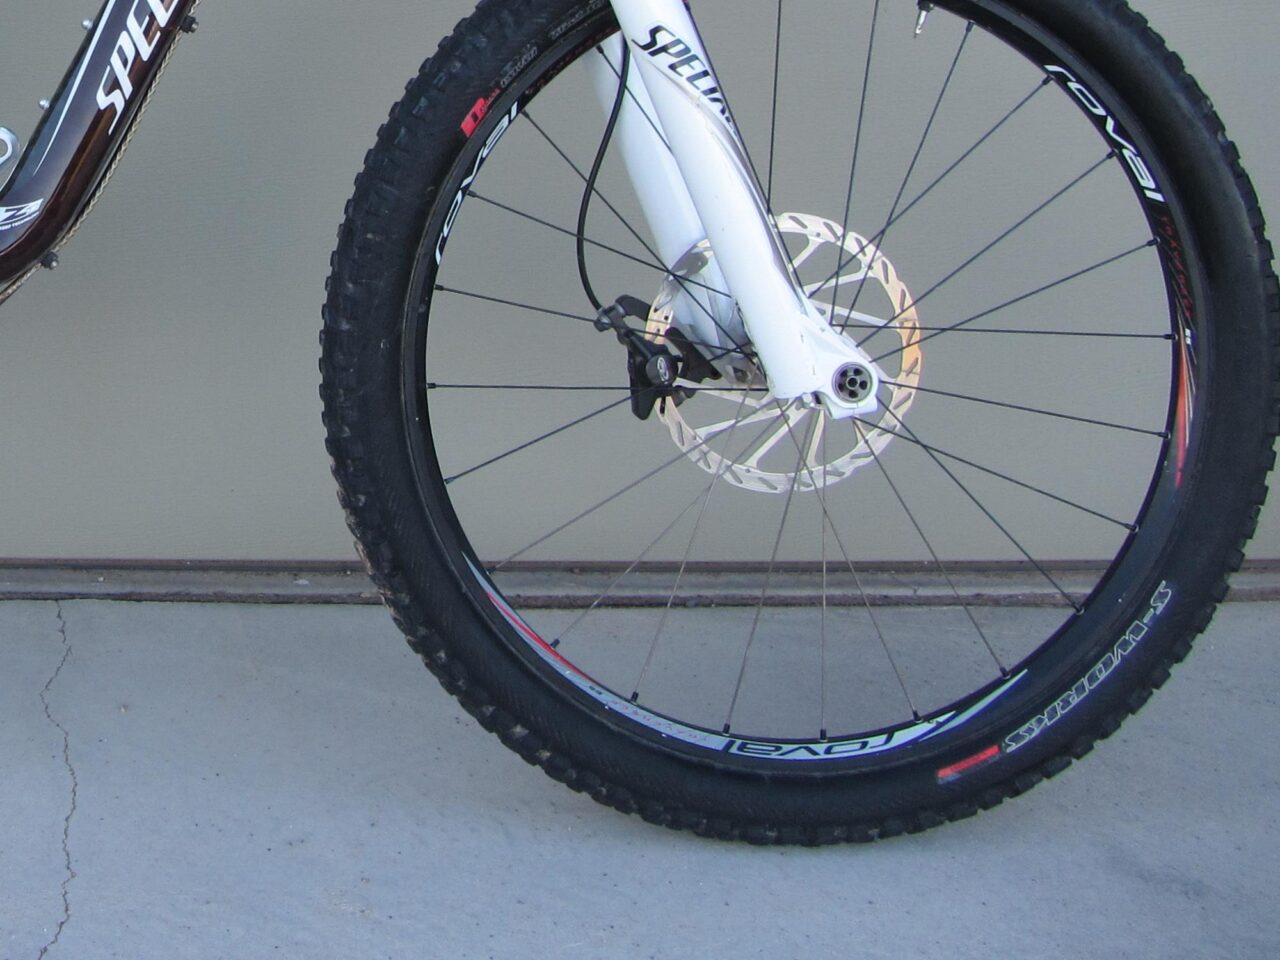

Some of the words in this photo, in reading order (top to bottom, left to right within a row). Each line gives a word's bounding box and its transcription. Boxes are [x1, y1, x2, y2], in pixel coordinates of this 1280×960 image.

[434, 100, 519, 266] roval
[1042, 64, 1166, 203] roval
[1004, 579, 1173, 753] S-WORKS
[720, 731, 896, 758] roval
